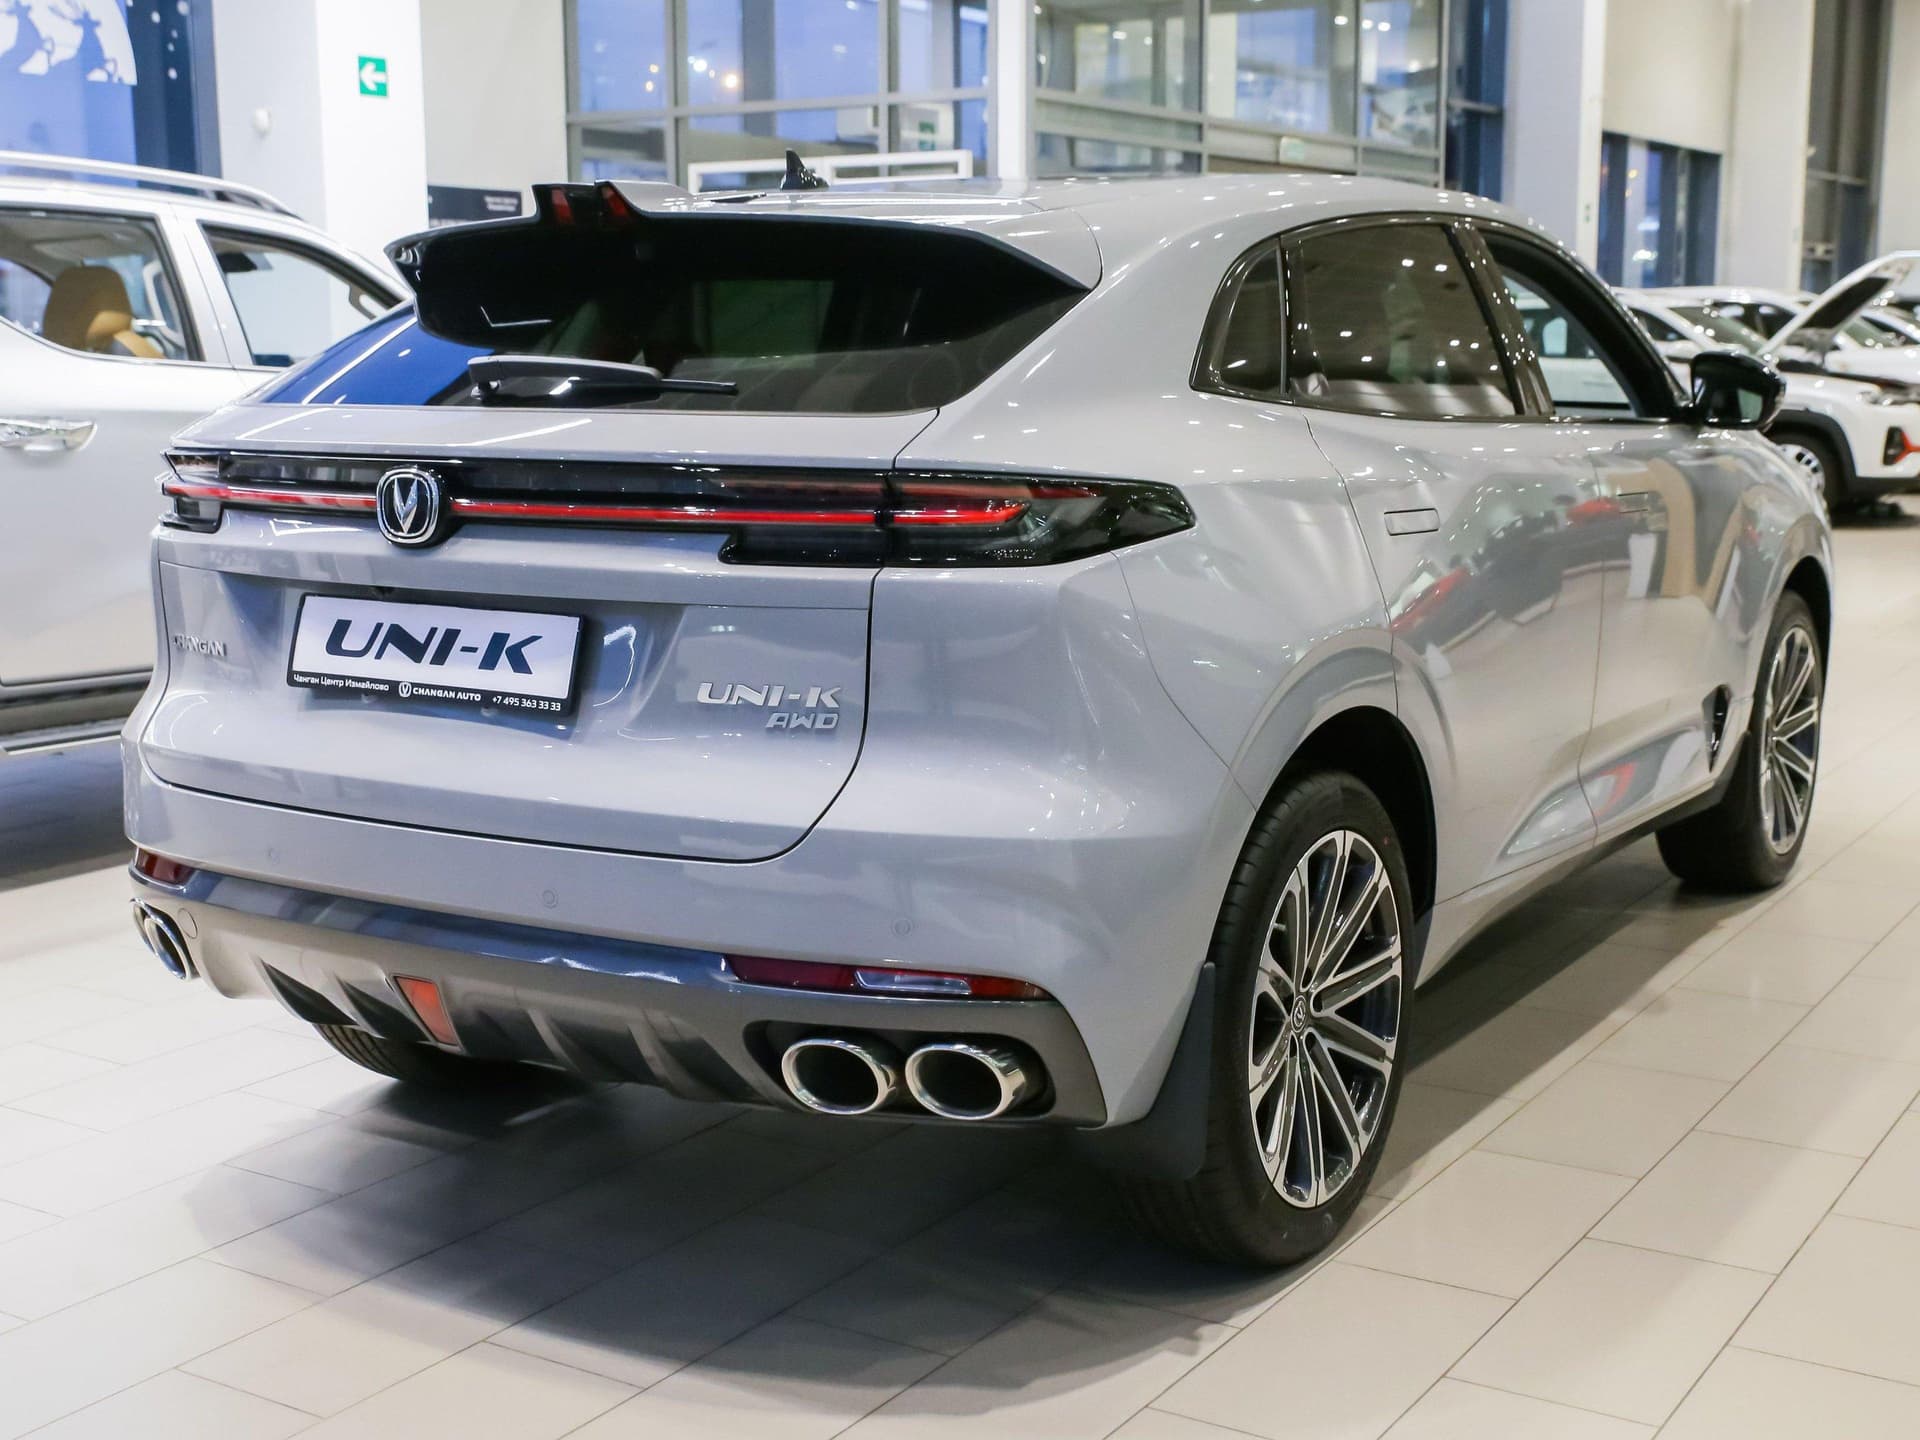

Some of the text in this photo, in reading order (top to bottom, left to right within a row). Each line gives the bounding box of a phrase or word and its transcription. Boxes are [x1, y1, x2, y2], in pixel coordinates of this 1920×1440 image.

[325, 618, 543, 675] UNI-K
[293, 673, 390, 691] Чанган Центр Измайлово
[412, 687, 482, 702] CHANGAN AUTO
[492, 695, 561, 711] +7 495 363 33 33
[696, 682, 841, 708] UNI-K
[765, 712, 839, 729] AWD
